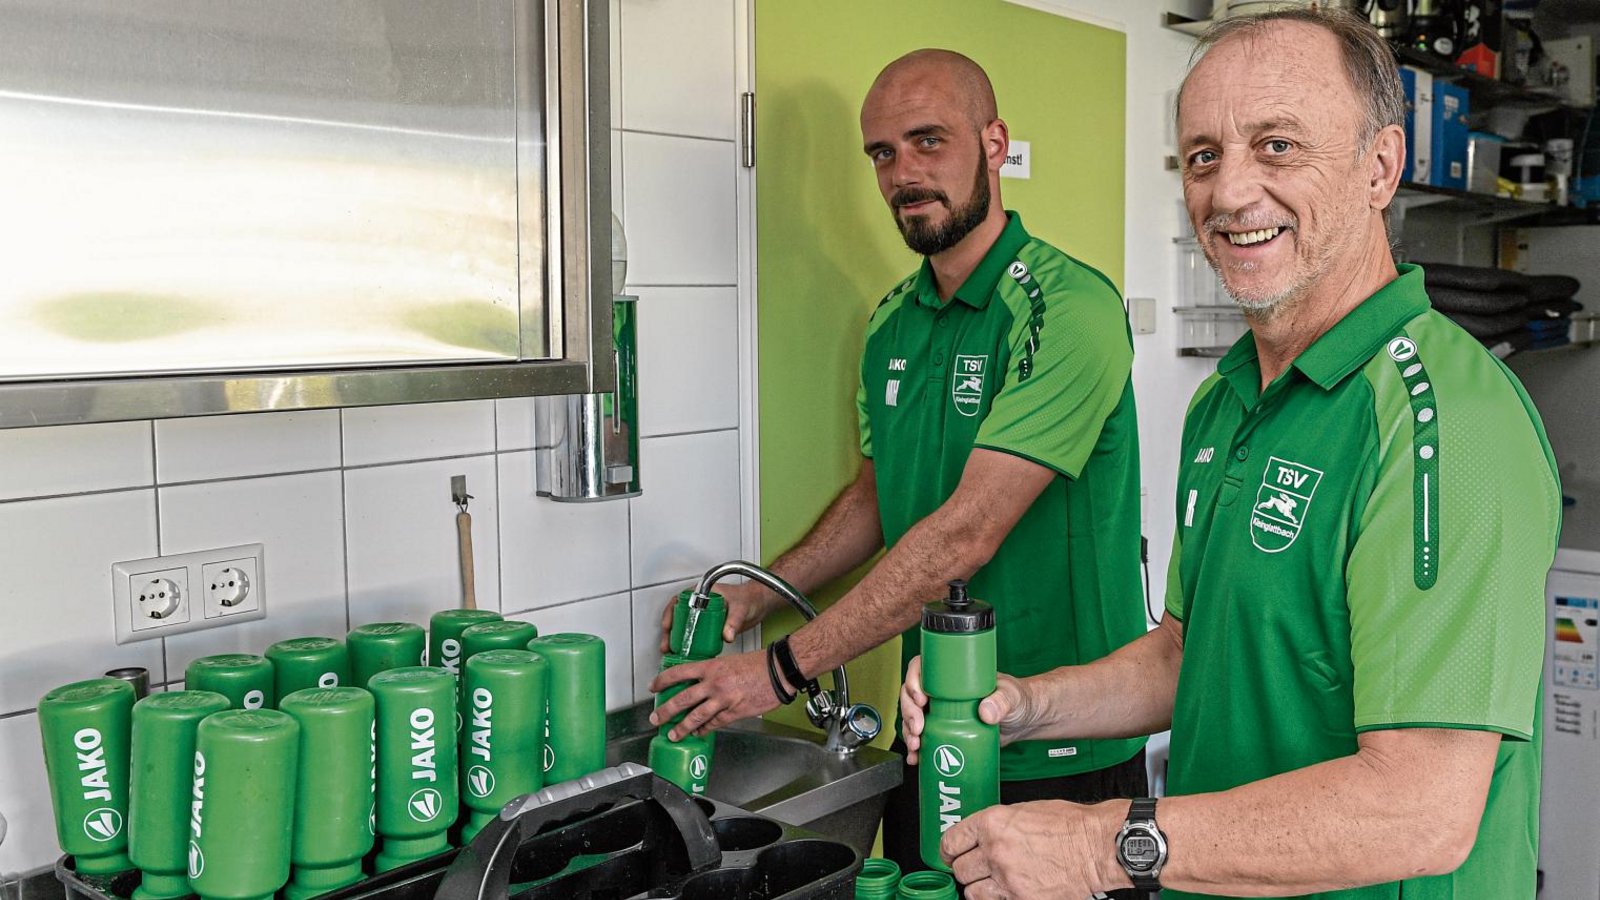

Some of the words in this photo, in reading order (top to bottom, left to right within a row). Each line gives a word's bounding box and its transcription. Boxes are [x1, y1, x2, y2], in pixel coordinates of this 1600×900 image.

[1003, 154, 1023, 166] nst!
[963, 359, 983, 372] TSV
[1277, 467, 1309, 489] TSV
[410, 708, 435, 782] JAKO
[471, 687, 493, 762] JAKO
[74, 728, 112, 801] JAKO
[190, 751, 206, 838] JAKO
[938, 781, 962, 840] JAK
